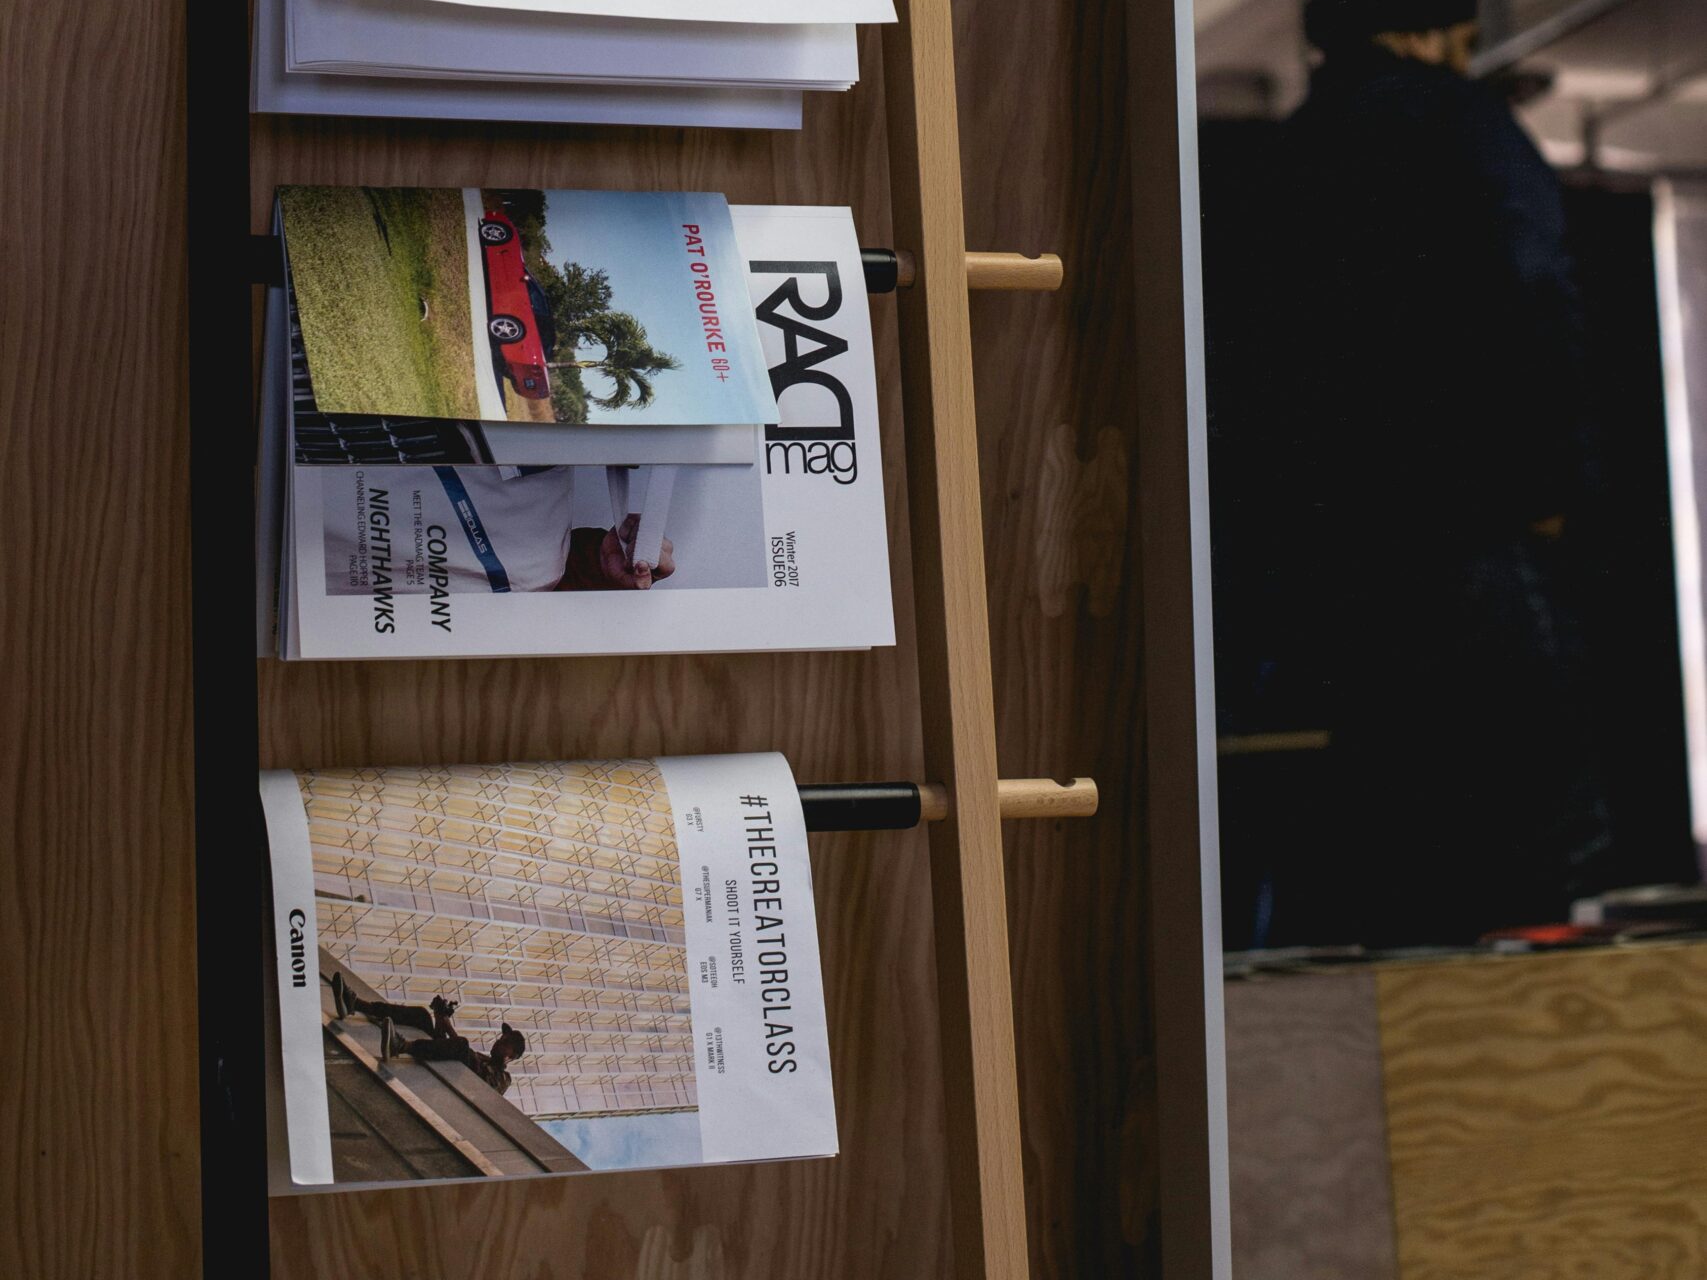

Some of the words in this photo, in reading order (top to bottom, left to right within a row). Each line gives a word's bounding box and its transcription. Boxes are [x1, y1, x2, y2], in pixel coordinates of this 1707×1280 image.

[682, 224, 704, 257] PAT
[690, 262, 725, 353] O'ROURKE
[711, 358, 730, 382] 60+
[766, 442, 858, 485] mag
[356, 471, 366, 520] CHANNELING
[413, 490, 421, 511] MEET
[414, 514, 422, 526] THE
[358, 522, 366, 554] EDWARD
[415, 528, 423, 562] RADMAG
[785, 531, 797, 564] Winter
[349, 555, 358, 575] PAGE
[359, 556, 368, 586] HOPPER
[369, 488, 395, 634] NIGHTHAWKS
[406, 560, 414, 579] PAGE
[771, 537, 786, 587] ISSUE06
[787, 565, 799, 587] 2017
[427, 525, 451, 632] COMPANY
[725, 879, 740, 914] SHOOT
[728, 917, 740, 928] IT
[740, 795, 798, 1074] #THECREATORCLASS
[289, 909, 307, 987] Canon
[729, 930, 745, 984] YOURSELF
